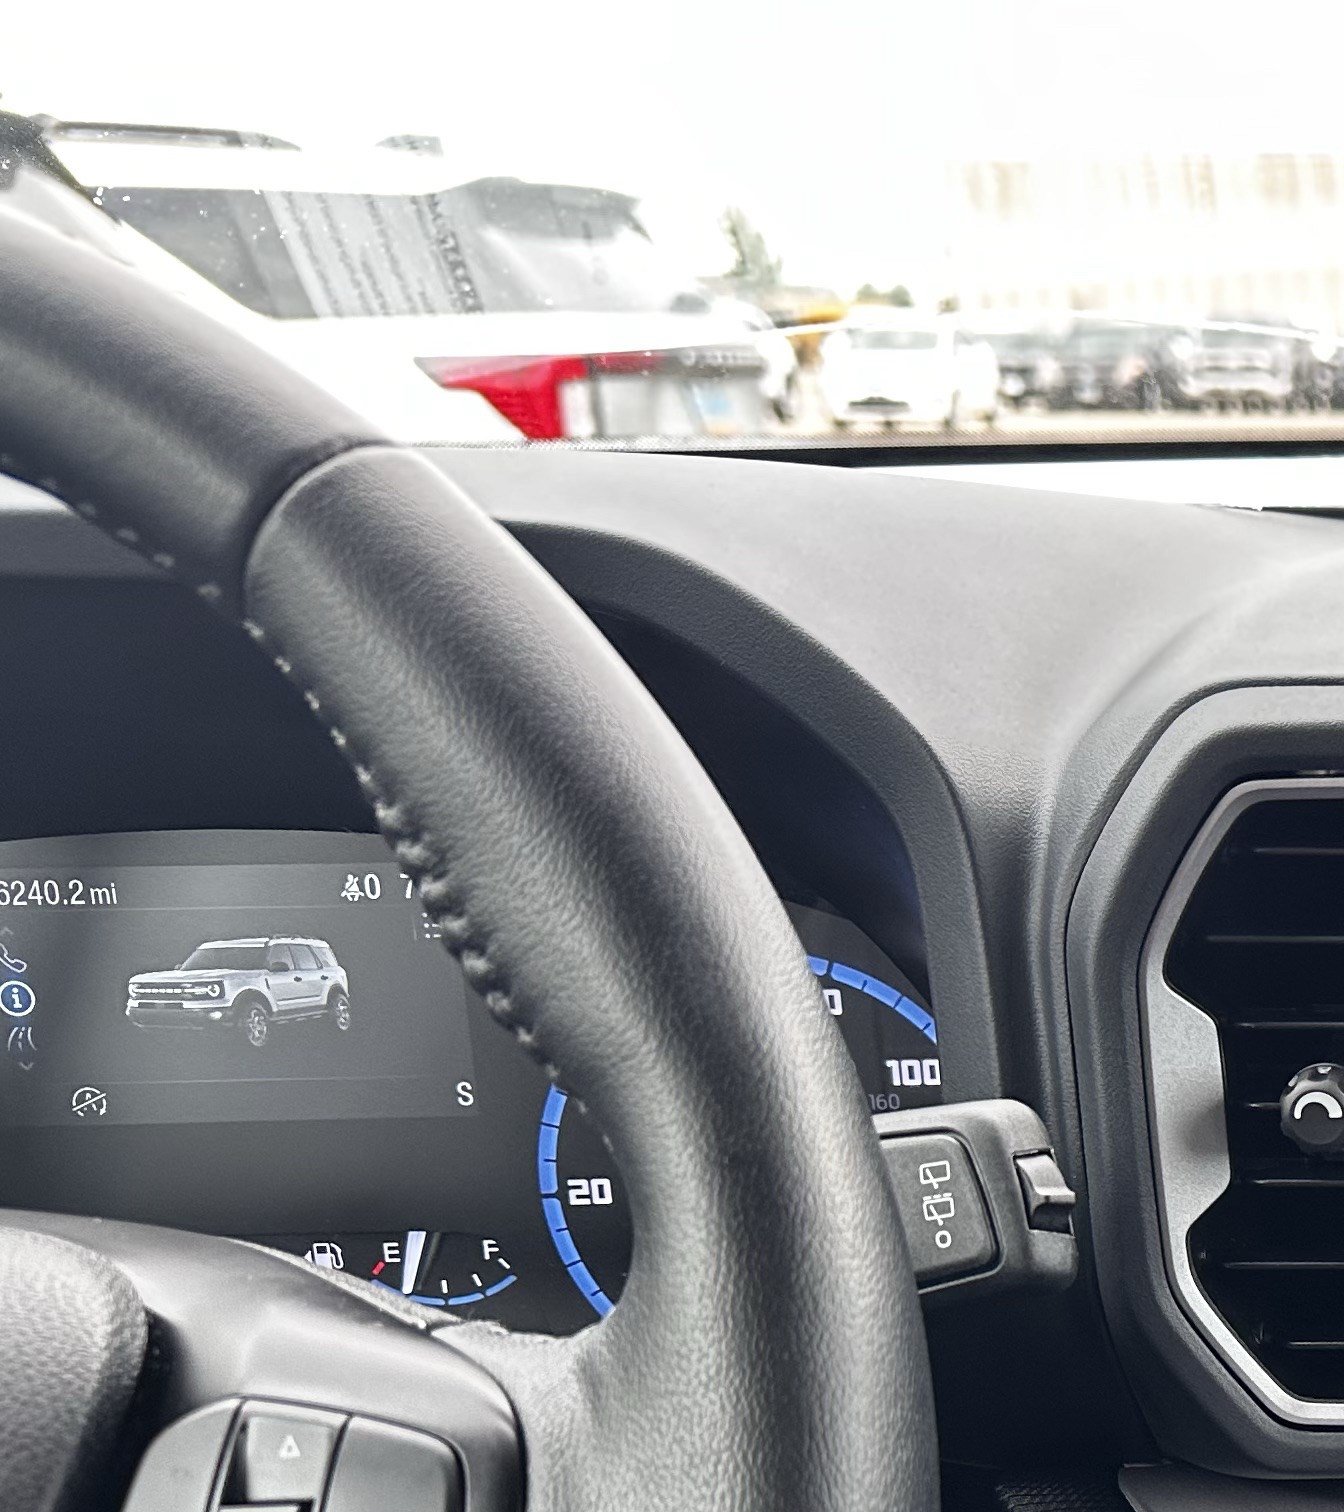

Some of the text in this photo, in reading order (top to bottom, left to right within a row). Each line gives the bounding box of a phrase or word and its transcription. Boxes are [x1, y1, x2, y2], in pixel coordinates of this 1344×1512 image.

[89, 882, 118, 906] mi
[885, 1058, 941, 1086] 100
[456, 1082, 474, 1107] S
[567, 1178, 613, 1206] 20
[383, 1242, 401, 1264] E
[483, 1240, 499, 1260] F
